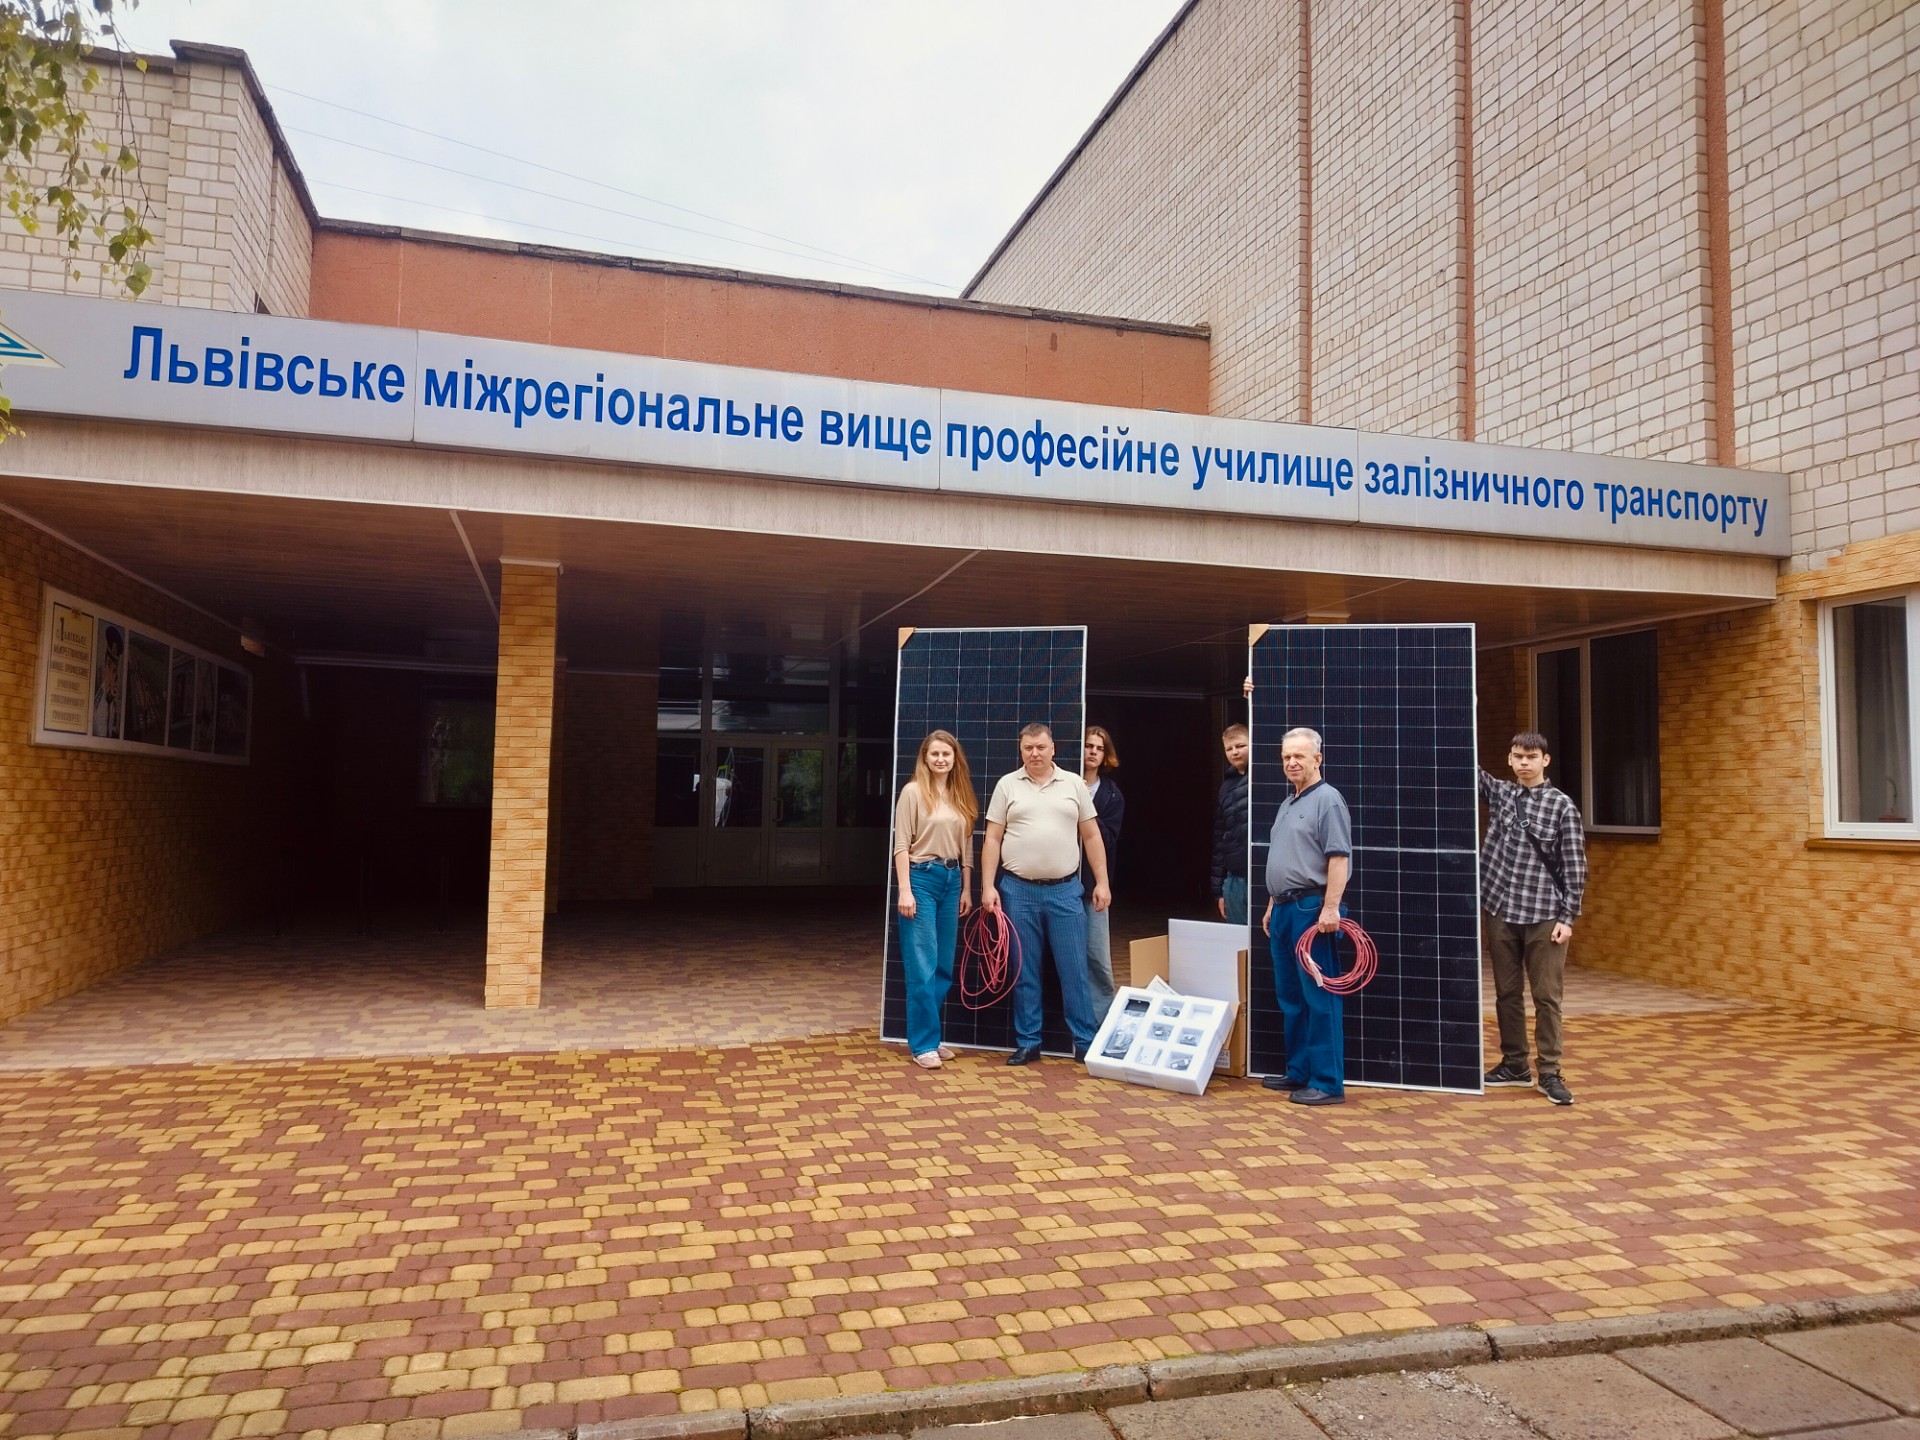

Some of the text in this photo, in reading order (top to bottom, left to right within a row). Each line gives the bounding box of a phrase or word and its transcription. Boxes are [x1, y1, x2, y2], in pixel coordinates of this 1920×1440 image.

[124, 326, 1768, 537] Львівське міжрегіональне вище професійне училище залізничного транспорту
